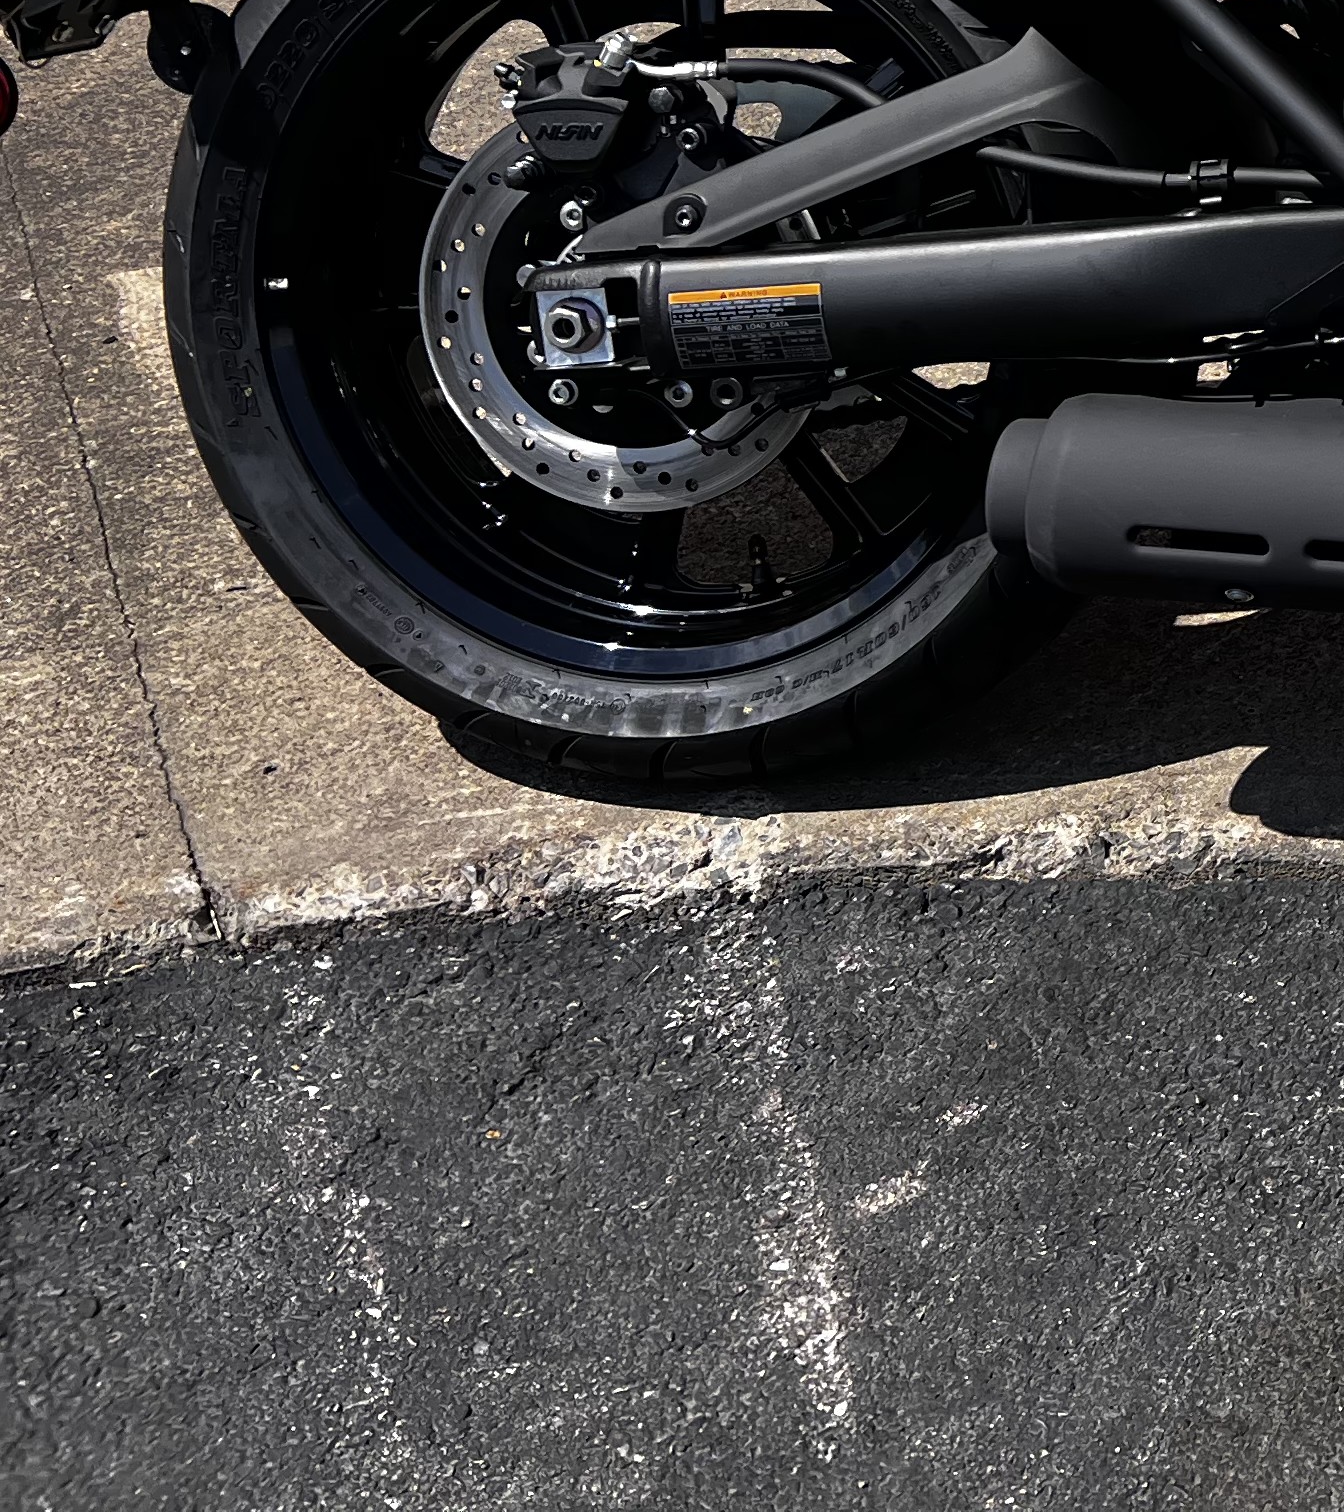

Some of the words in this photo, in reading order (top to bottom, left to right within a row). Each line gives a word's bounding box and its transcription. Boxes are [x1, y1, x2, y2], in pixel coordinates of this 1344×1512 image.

[728, 289, 768, 298] WARNING
[727, 323, 742, 331] AND
[746, 322, 766, 330] LOAD
[769, 321, 789, 329] DATA
